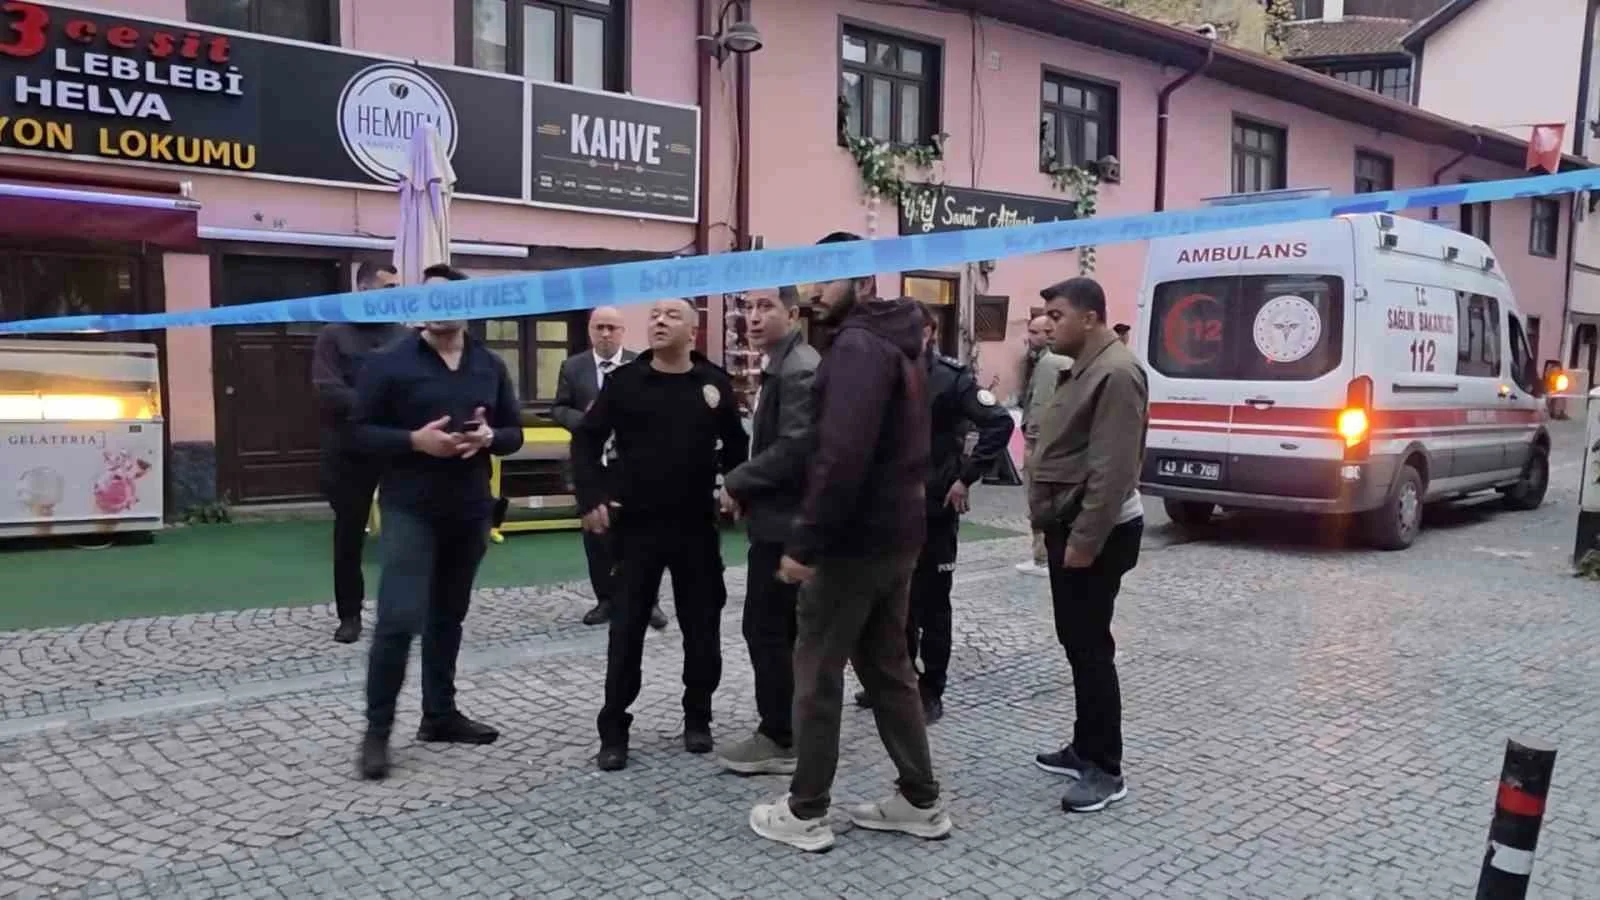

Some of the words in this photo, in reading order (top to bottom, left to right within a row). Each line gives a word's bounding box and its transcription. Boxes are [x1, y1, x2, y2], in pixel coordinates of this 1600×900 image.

[0, 1, 49, 57] 3
[55, 48, 244, 96] LEBLEBİ
[15, 75, 172, 121] HELVA
[99, 127, 256, 170] LOKUMU
[571, 113, 661, 165] KAHVE
[1177, 242, 1308, 264] AMBULANS
[1410, 337, 1437, 372] 112
[8, 434, 97, 445] GELATERIA
